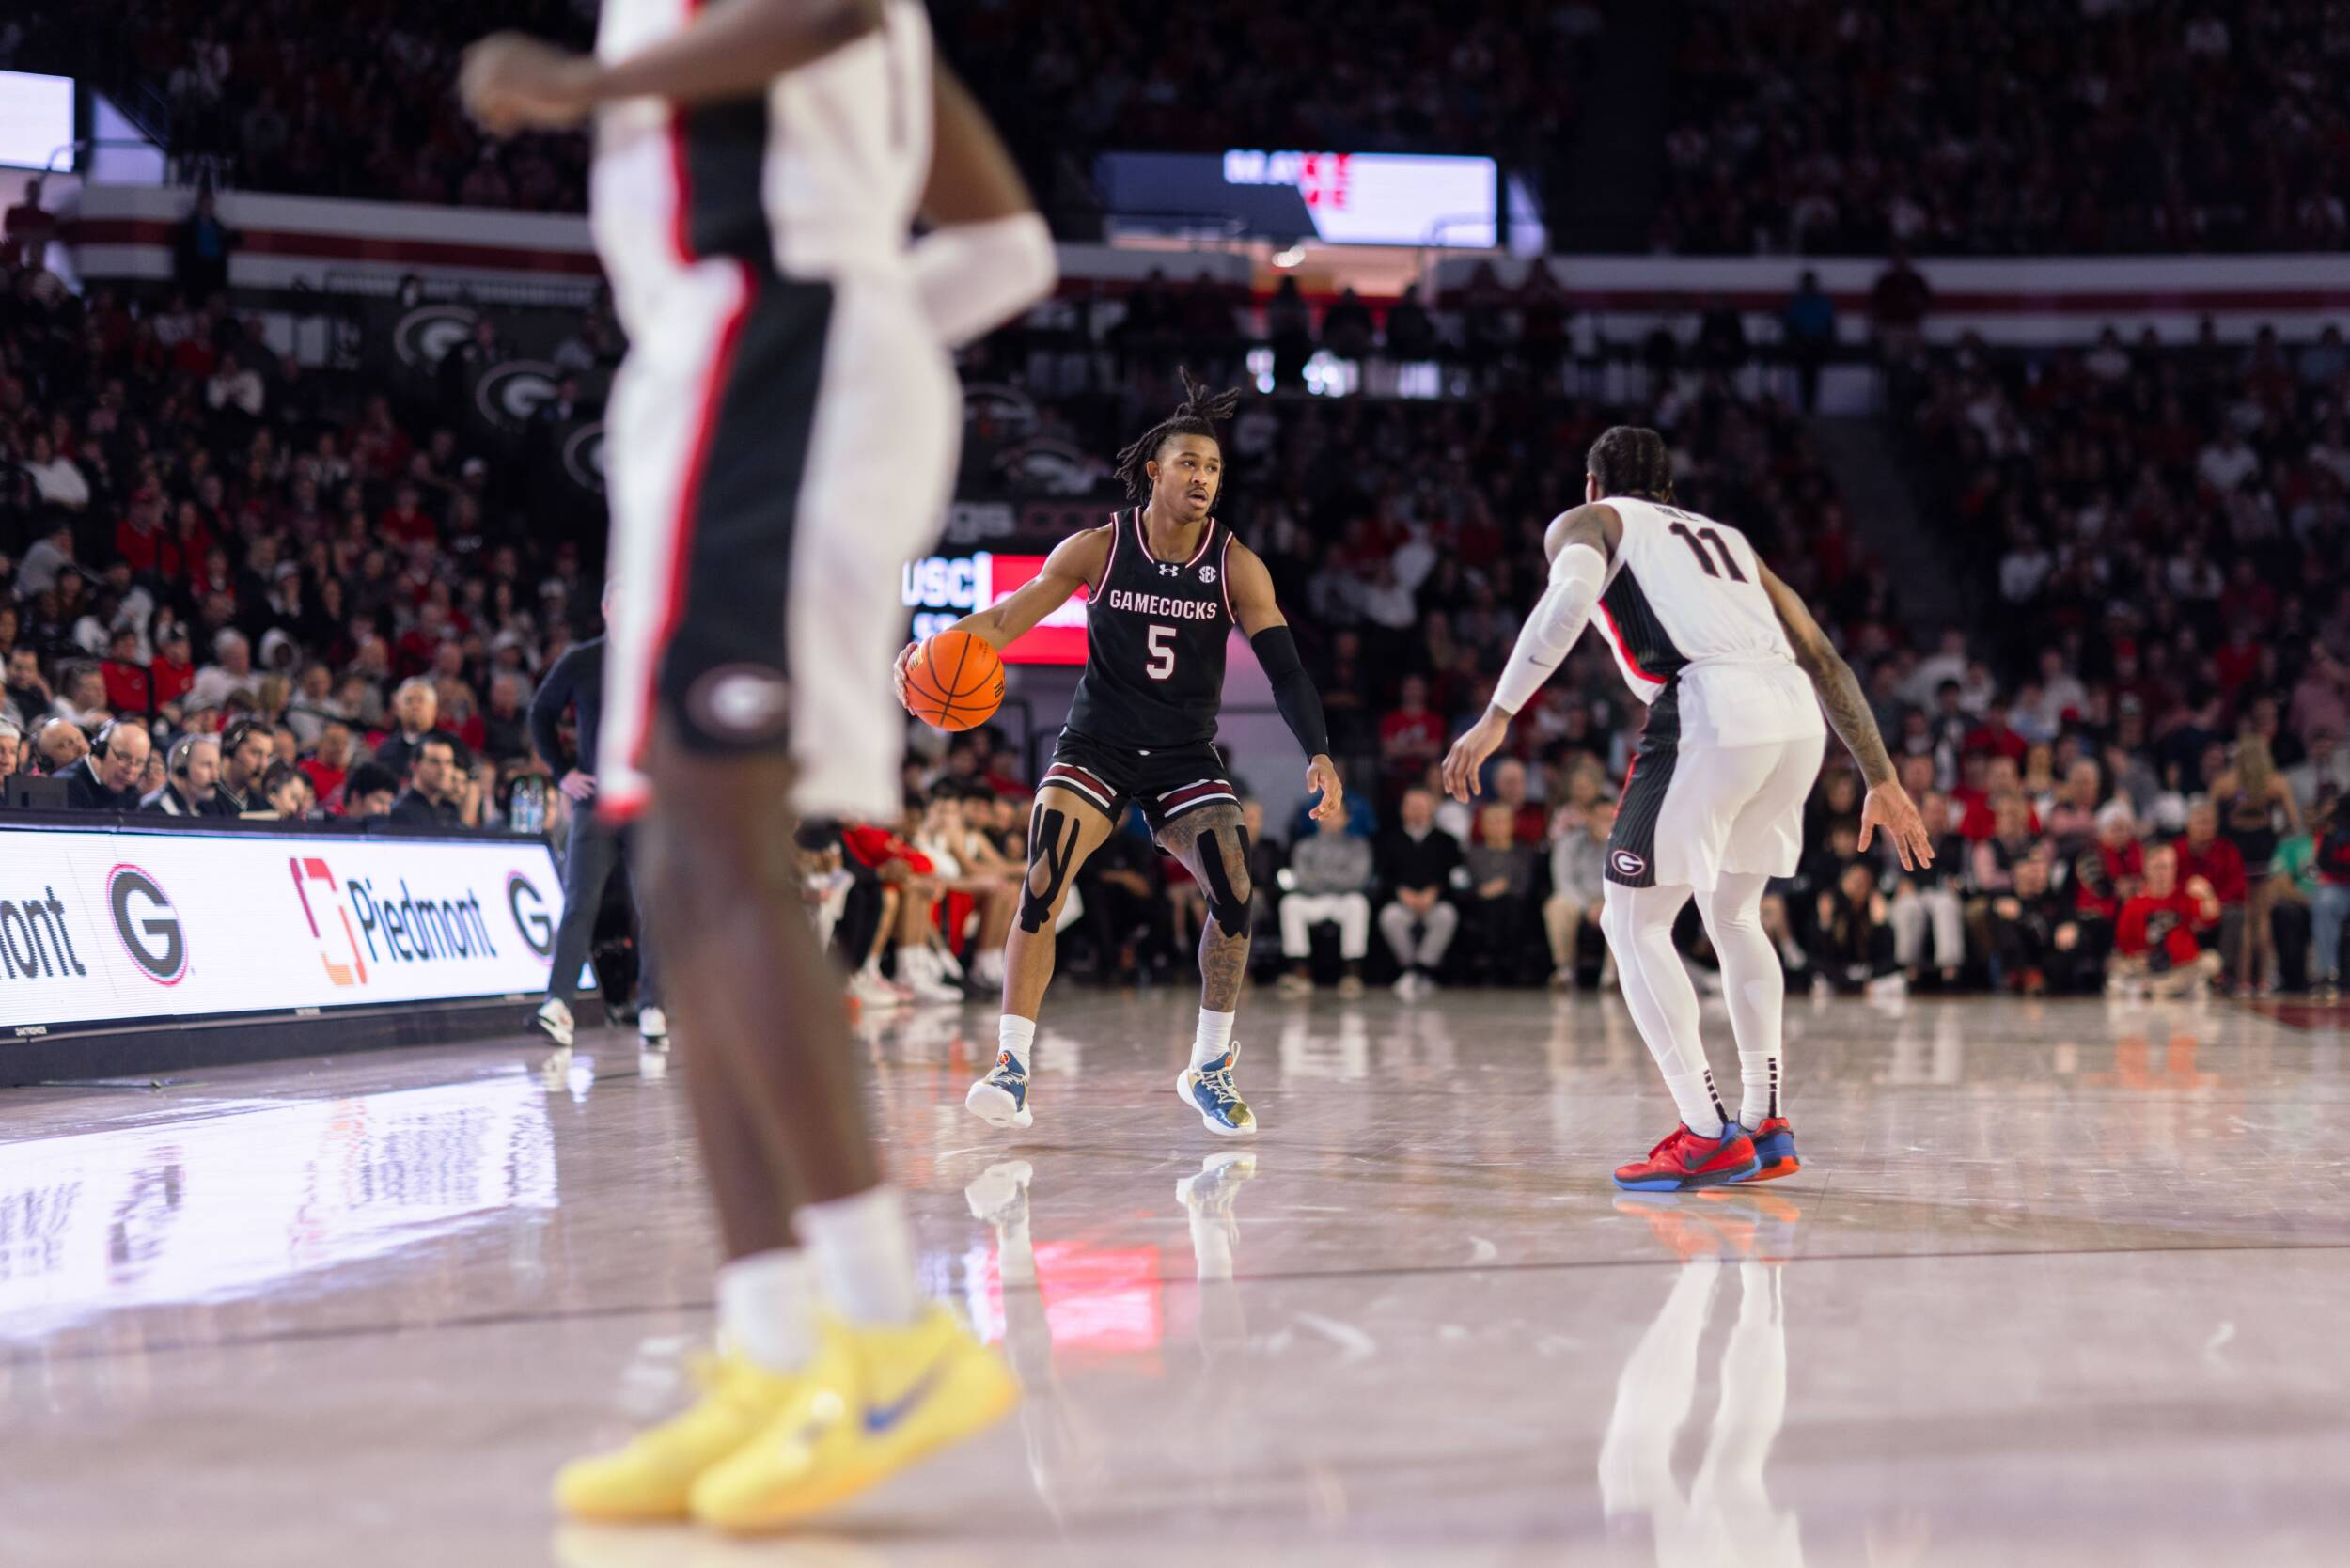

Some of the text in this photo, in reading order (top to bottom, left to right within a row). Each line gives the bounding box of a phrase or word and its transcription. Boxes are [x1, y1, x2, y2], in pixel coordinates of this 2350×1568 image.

[1198, 565, 1217, 584] SEC
[1668, 521, 1750, 584] 11
[902, 556, 973, 608] USC
[1109, 589, 1218, 620] GAMECOCKS
[1146, 624, 1177, 680] 5
[347, 877, 497, 964] Piedmont
